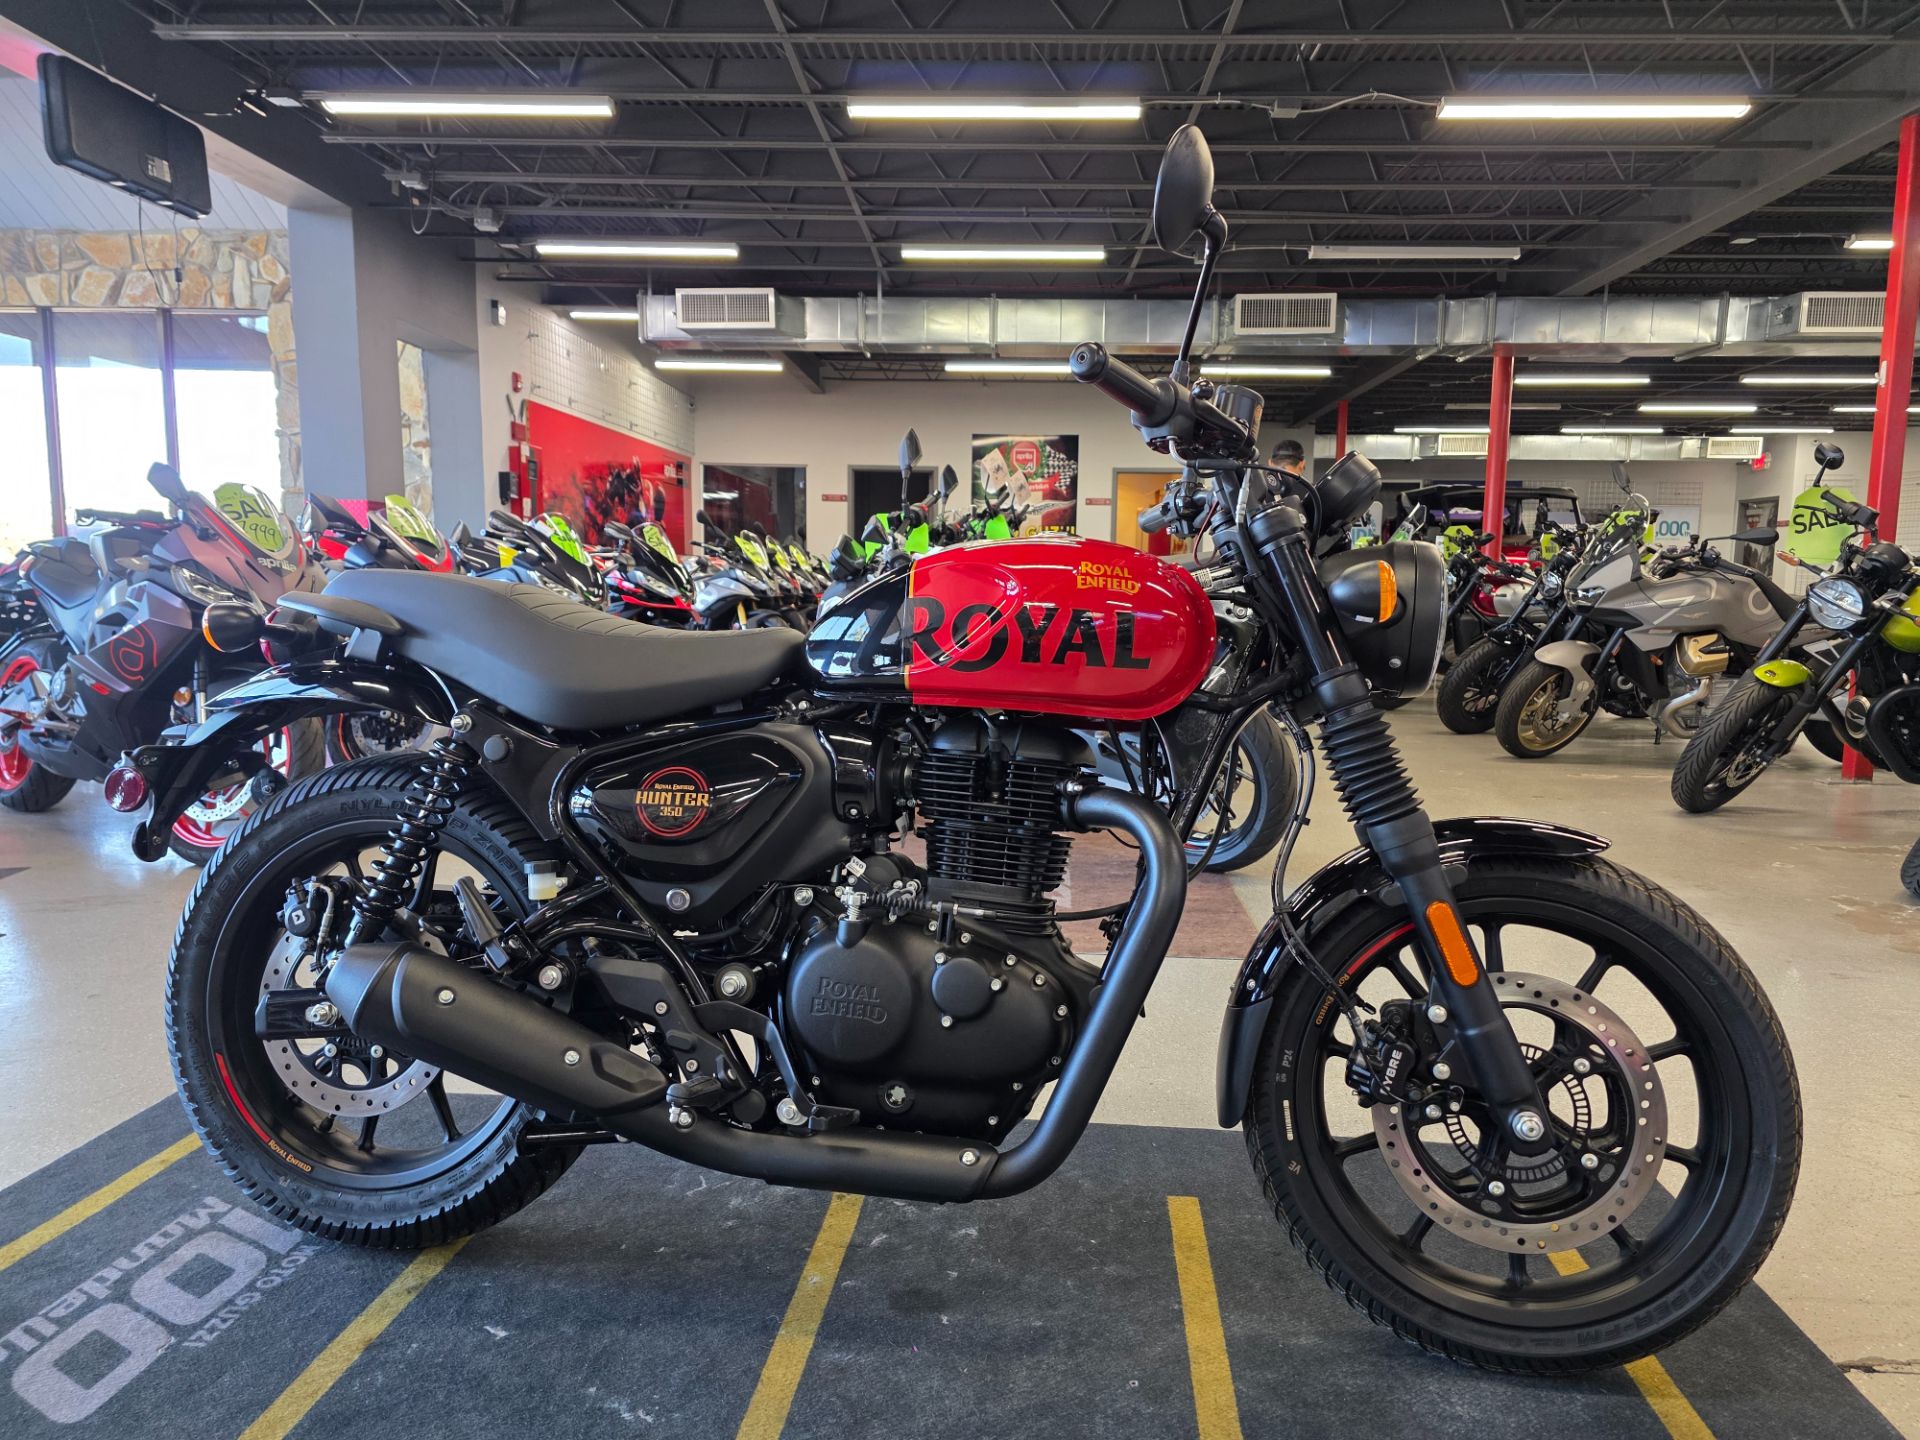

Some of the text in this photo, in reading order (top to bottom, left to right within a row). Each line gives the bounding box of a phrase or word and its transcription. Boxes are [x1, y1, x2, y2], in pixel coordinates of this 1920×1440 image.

[221, 500, 273, 520] SAL
[1793, 511, 1838, 534] SAL
[257, 557, 297, 572] aprilia
[1079, 561, 1133, 578] ROYAL
[1076, 575, 1140, 595] ENFIELD
[898, 597, 1152, 673] ROYAL
[635, 790, 709, 807] HUNTER
[660, 806, 683, 817] 350
[819, 977, 881, 1003] ROYAL
[811, 996, 888, 1025] ENFIELD
[1315, 995, 1335, 1025] ENFIELD
[268, 1139, 313, 1174] ROYAL ENFIELD
[182, 1291, 262, 1348] GUZZI
